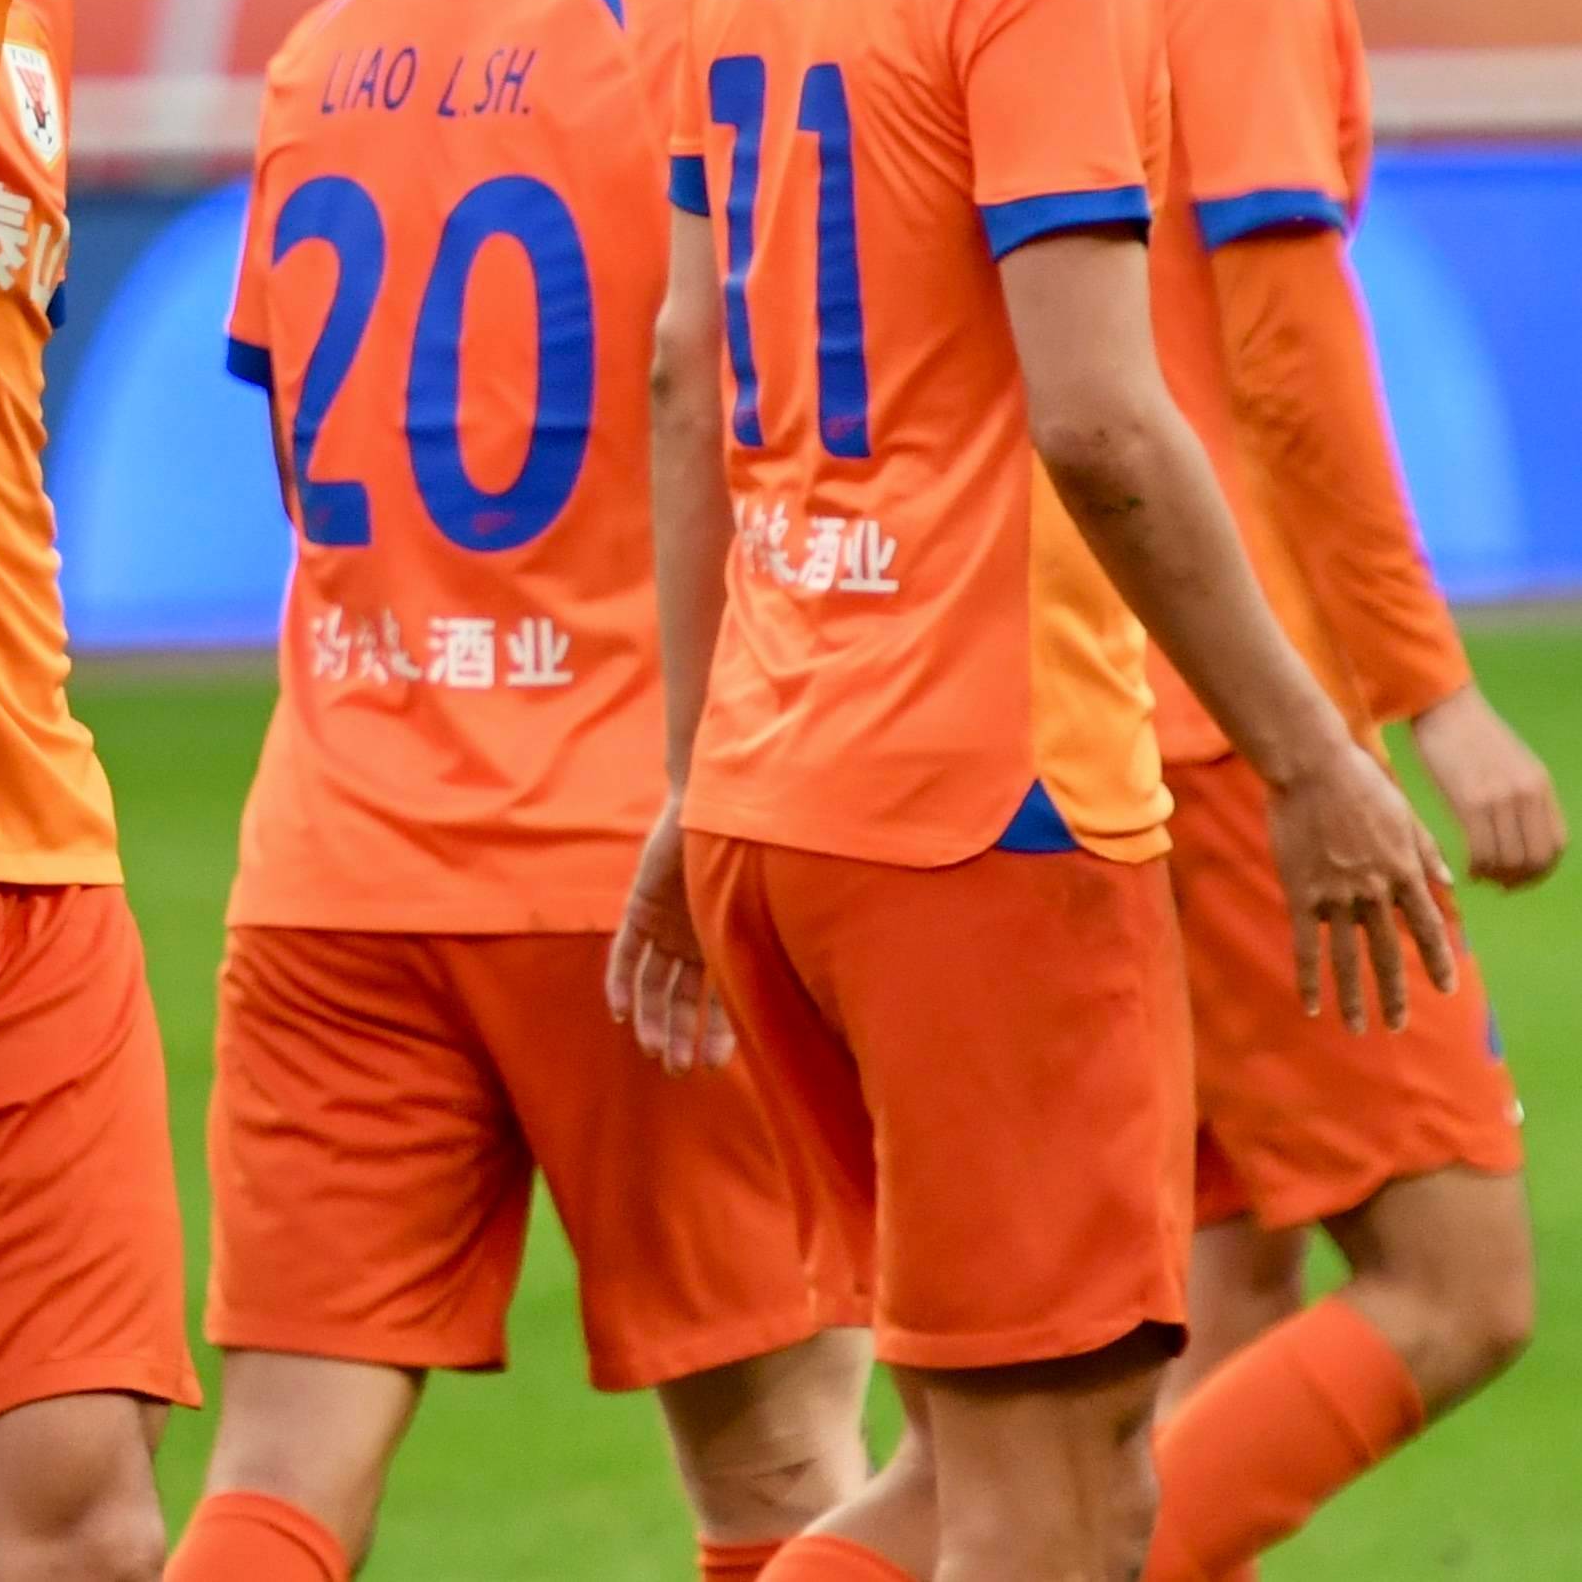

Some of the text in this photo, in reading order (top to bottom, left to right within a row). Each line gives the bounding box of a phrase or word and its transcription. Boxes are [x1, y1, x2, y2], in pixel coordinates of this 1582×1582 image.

[321, 46, 417, 115] LIAO
[708, 54, 871, 459] 11
[273, 174, 594, 552] 20
